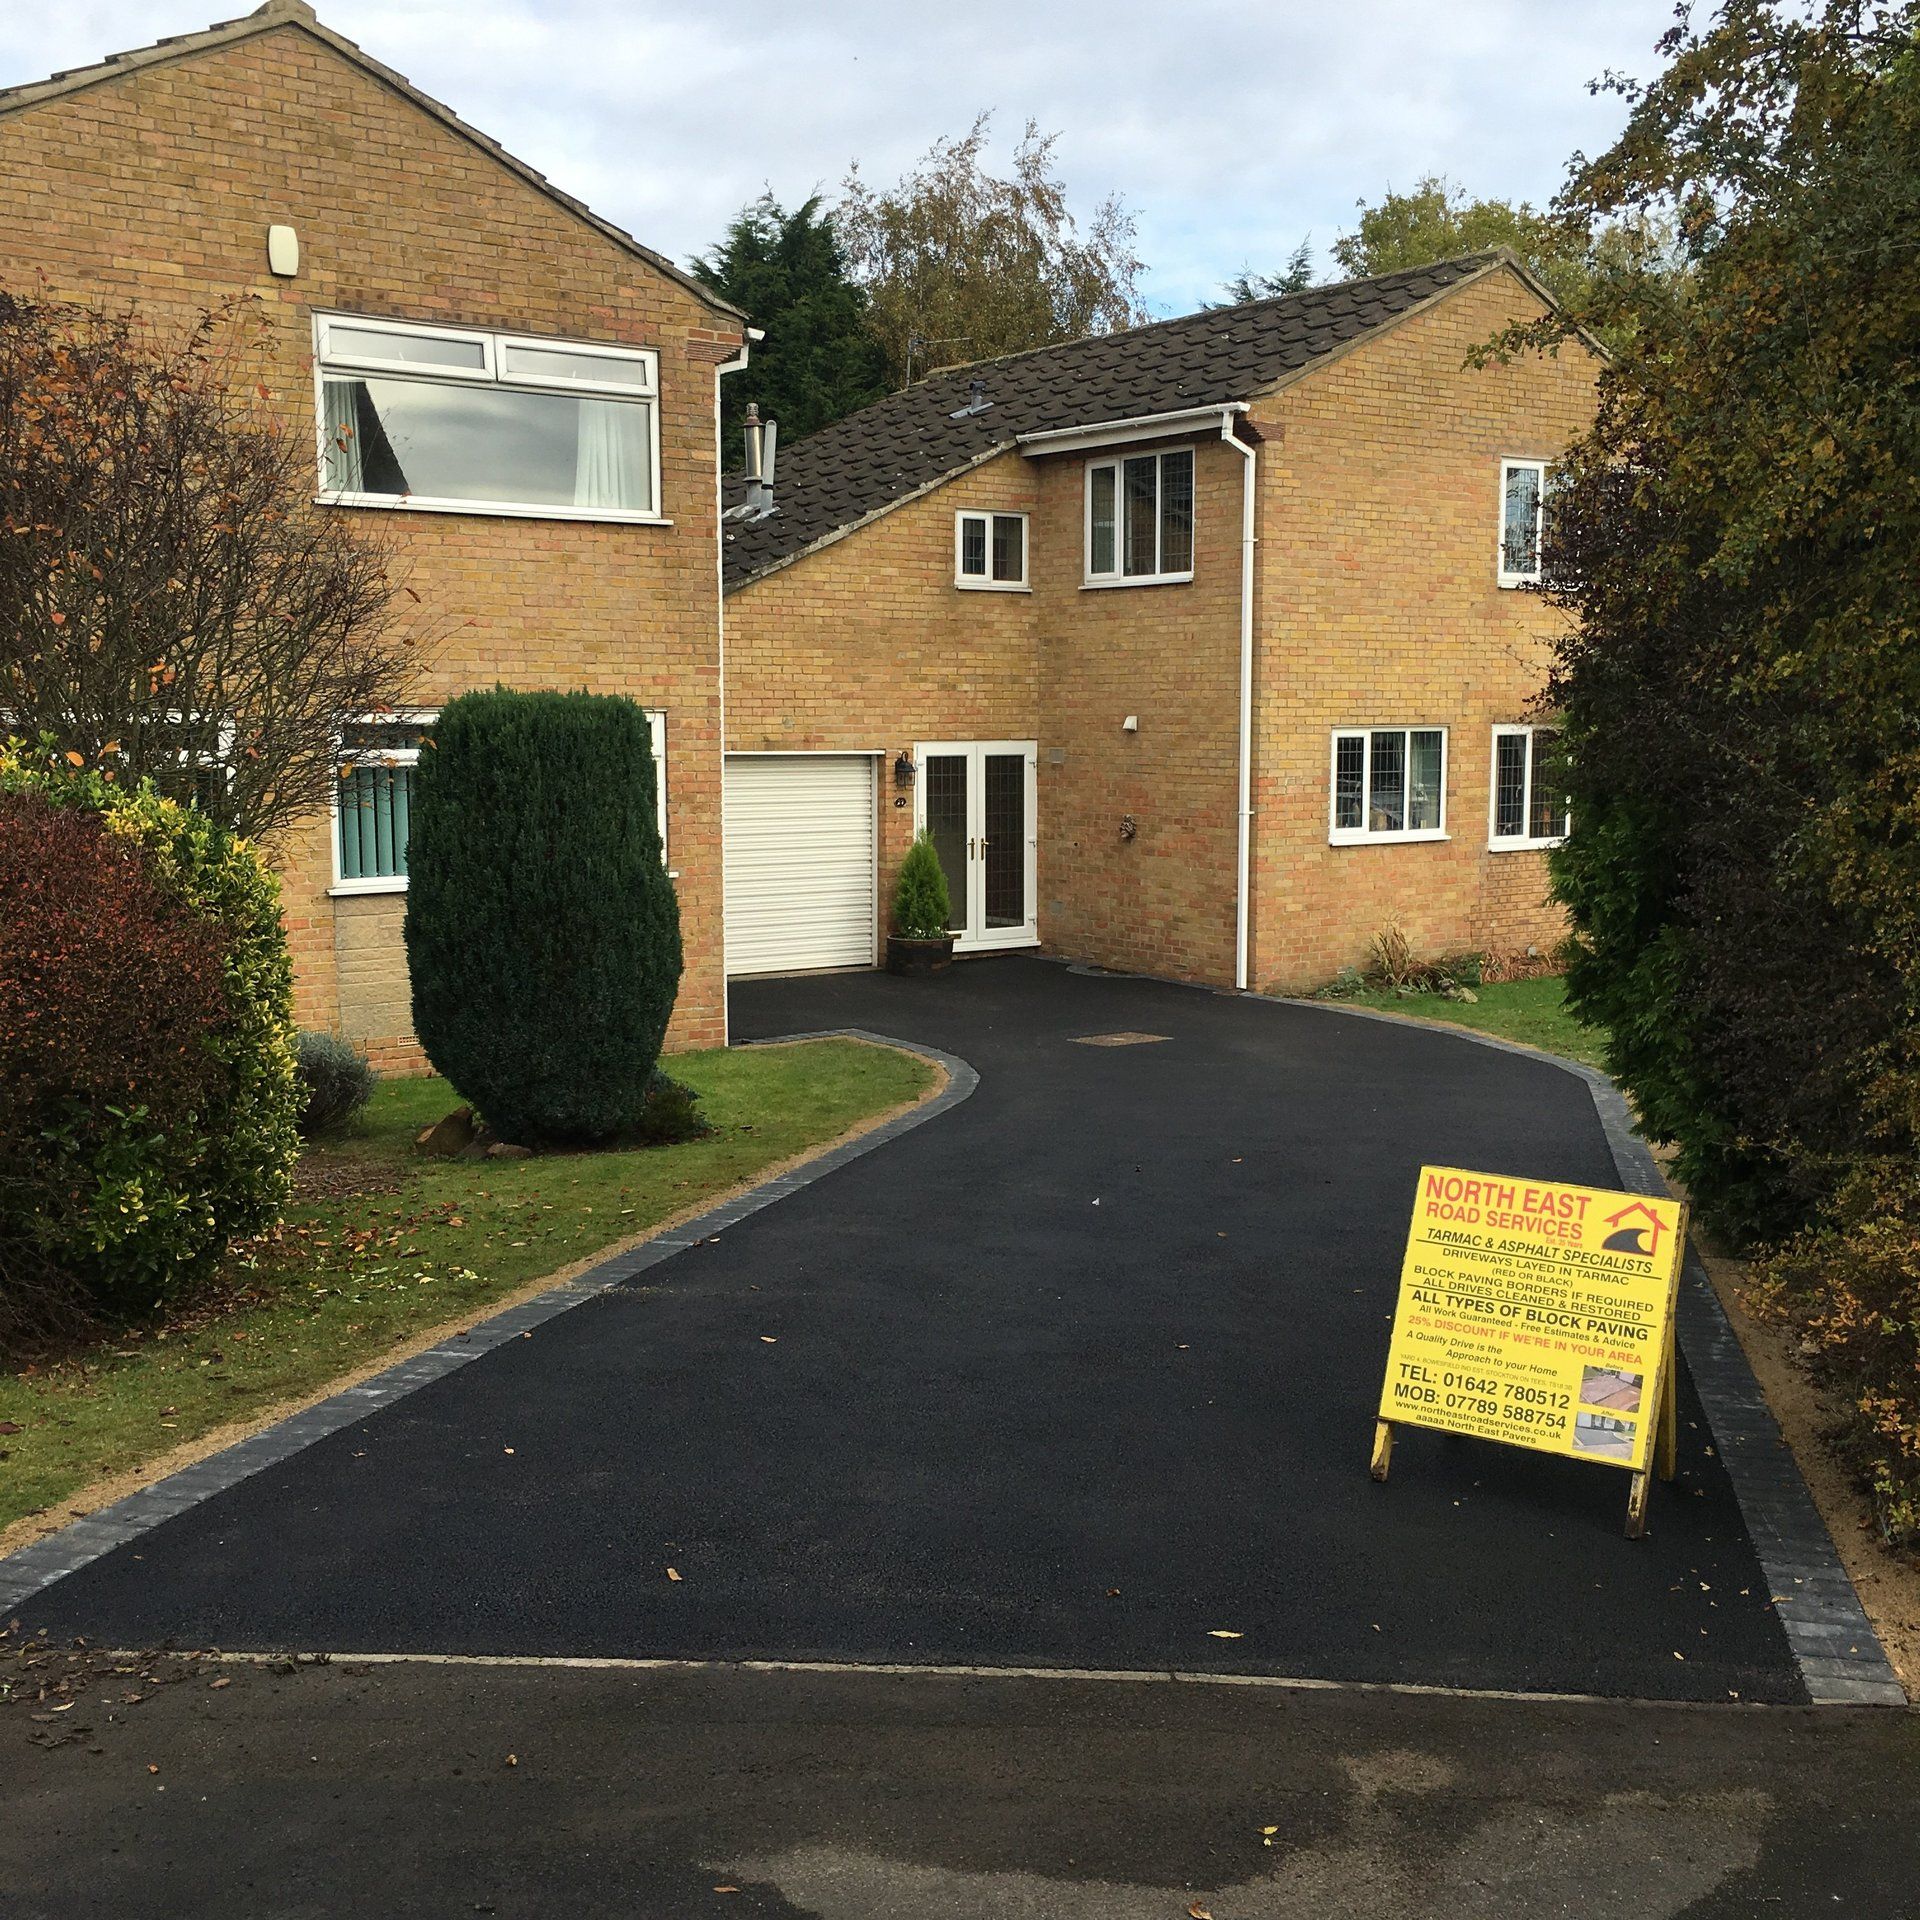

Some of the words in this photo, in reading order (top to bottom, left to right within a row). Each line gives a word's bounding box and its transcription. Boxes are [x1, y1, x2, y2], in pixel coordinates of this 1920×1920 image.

[1426, 1175, 1515, 1209] NORTH
[1523, 1189, 1592, 1220] EAST
[1426, 1202, 1480, 1223] ROAD
[1486, 1211, 1582, 1240] SERVICES
[1428, 1228, 1482, 1247] TARMAC
[1485, 1237, 1494, 1248] &
[1498, 1239, 1560, 1259] ASPHALT
[1563, 1249, 1653, 1274] SPECIALISTS
[1443, 1248, 1512, 1266] DRIVEWAYS
[1516, 1260, 1555, 1274] LAYED
[1559, 1266, 1572, 1276] IN
[1576, 1269, 1630, 1285] TARMAC
[1414, 1265, 1455, 1279] BLOCK
[1459, 1272, 1503, 1287] PAVING
[1507, 1281, 1568, 1298] BORDERS
[1572, 1291, 1583, 1300] IF
[1586, 1293, 1654, 1313] REQUIRED
[1423, 1277, 1445, 1288] ALL
[1448, 1282, 1493, 1296] DRIVES
[1496, 1289, 1555, 1307] CLEANED
[1558, 1300, 1567, 1309] &
[1571, 1302, 1641, 1321] RESTORED
[1492, 1268, 1516, 1278] (RED
[1536, 1274, 1573, 1288] BLACK)
[1412, 1290, 1440, 1304] ALL
[1445, 1295, 1495, 1314] TYPES
[1499, 1304, 1522, 1318] OF
[1526, 1309, 1582, 1329] BLOCK
[1587, 1319, 1648, 1341] PAVING
[1419, 1304, 1431, 1313] All
[1434, 1307, 1457, 1318] Work
[1460, 1311, 1513, 1327] Guaranteed
[1520, 1322, 1541, 1333] Free
[1544, 1326, 1590, 1342] Estimates
[1593, 1335, 1600, 1343] &
[1602, 1336, 1635, 1349] Advice
[1406, 1330, 1414, 1338] A
[1416, 1332, 1448, 1346] Quality
[1450, 1337, 1475, 1349] Drive
[1476, 1342, 1485, 1351] is
[1487, 1345, 1503, 1355] the
[1408, 1315, 1431, 1327] 25%
[1434, 1319, 1496, 1338] DISCOUNT
[1499, 1330, 1510, 1340] IF
[1513, 1332, 1551, 1348] WE'RE
[1554, 1341, 1567, 1351] IN
[1571, 1343, 1606, 1358] YOUR
[1608, 1350, 1643, 1365] AREA
[1446, 1349, 1491, 1365] Approach
[1493, 1358, 1503, 1366] to
[1504, 1360, 1527, 1372] your
[1529, 1364, 1558, 1377] Home
[1394, 1382, 1440, 1405] MOB:
[1446, 1393, 1498, 1416] 07789
[1502, 1404, 1566, 1429] 588754
[1399, 1362, 1438, 1384] TEL:
[1443, 1372, 1498, 1395] 01642
[1504, 1383, 1570, 1410] 780512
[1395, 1400, 1561, 1440] www.northeastroadservices.co.uk
[1447, 1419, 1475, 1432] North
[1477, 1425, 1500, 1437] East
[1502, 1430, 1536, 1444] Pavers
